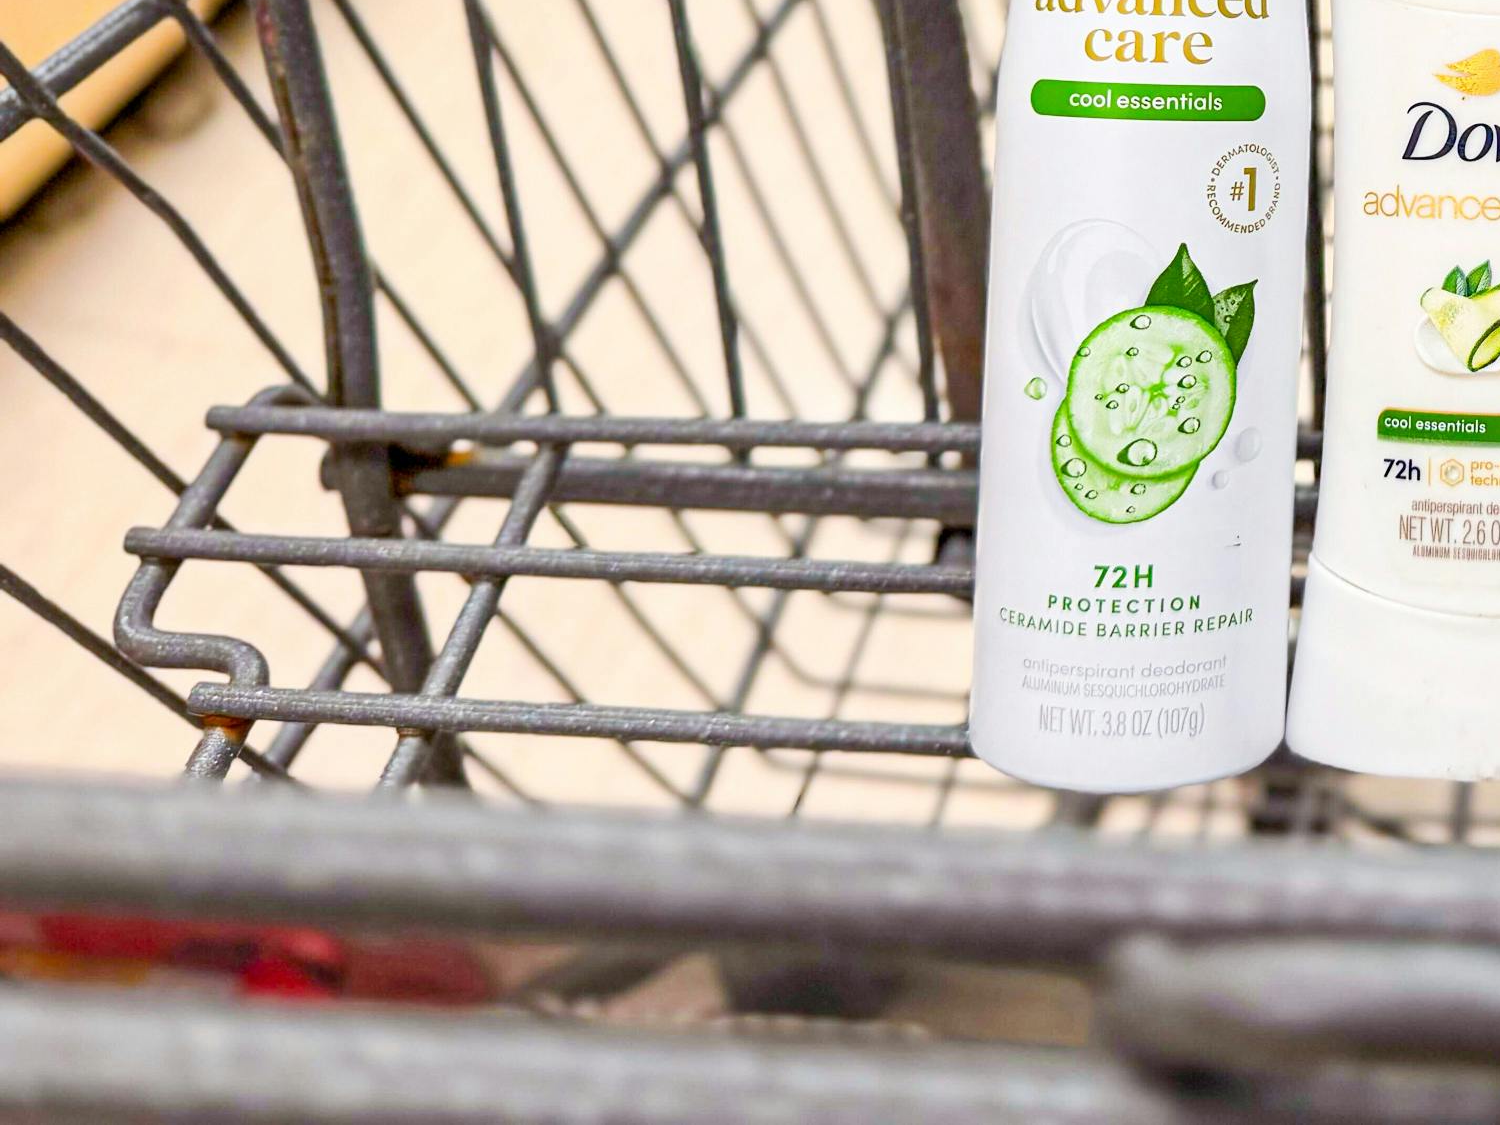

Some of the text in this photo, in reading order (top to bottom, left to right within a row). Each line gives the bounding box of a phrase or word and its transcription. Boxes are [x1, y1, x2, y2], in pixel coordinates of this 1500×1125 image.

[1084, 27, 1213, 65] care
[1068, 88, 1223, 112] cool essentials
[1212, 143, 1279, 176] DERMATOLOGIST
[1230, 167, 1257, 211] #1
[1207, 183, 1280, 234] RECOMMENDED BRAND
[1384, 416, 1486, 433] cool essentials
[1383, 458, 1421, 481] 72h
[1411, 499, 1483, 516] antiperspirant
[1399, 514, 1426, 541] NET
[1462, 520, 1486, 545] 2.6
[1093, 564, 1154, 589] 72H
[1048, 594, 1201, 614] PROTECTION
[1000, 607, 1254, 638] CERAMIDE BARRIER REPAIR
[1023, 654, 1227, 680] antiperspirant deodorant
[1022, 674, 1225, 699] ALUMINUM SESQUICHLOROHYDRATE
[1039, 703, 1065, 733] NET
[1102, 710, 1126, 736] 3.8
[1132, 710, 1154, 736] OZ
[1157, 702, 1205, 739] (107g)
